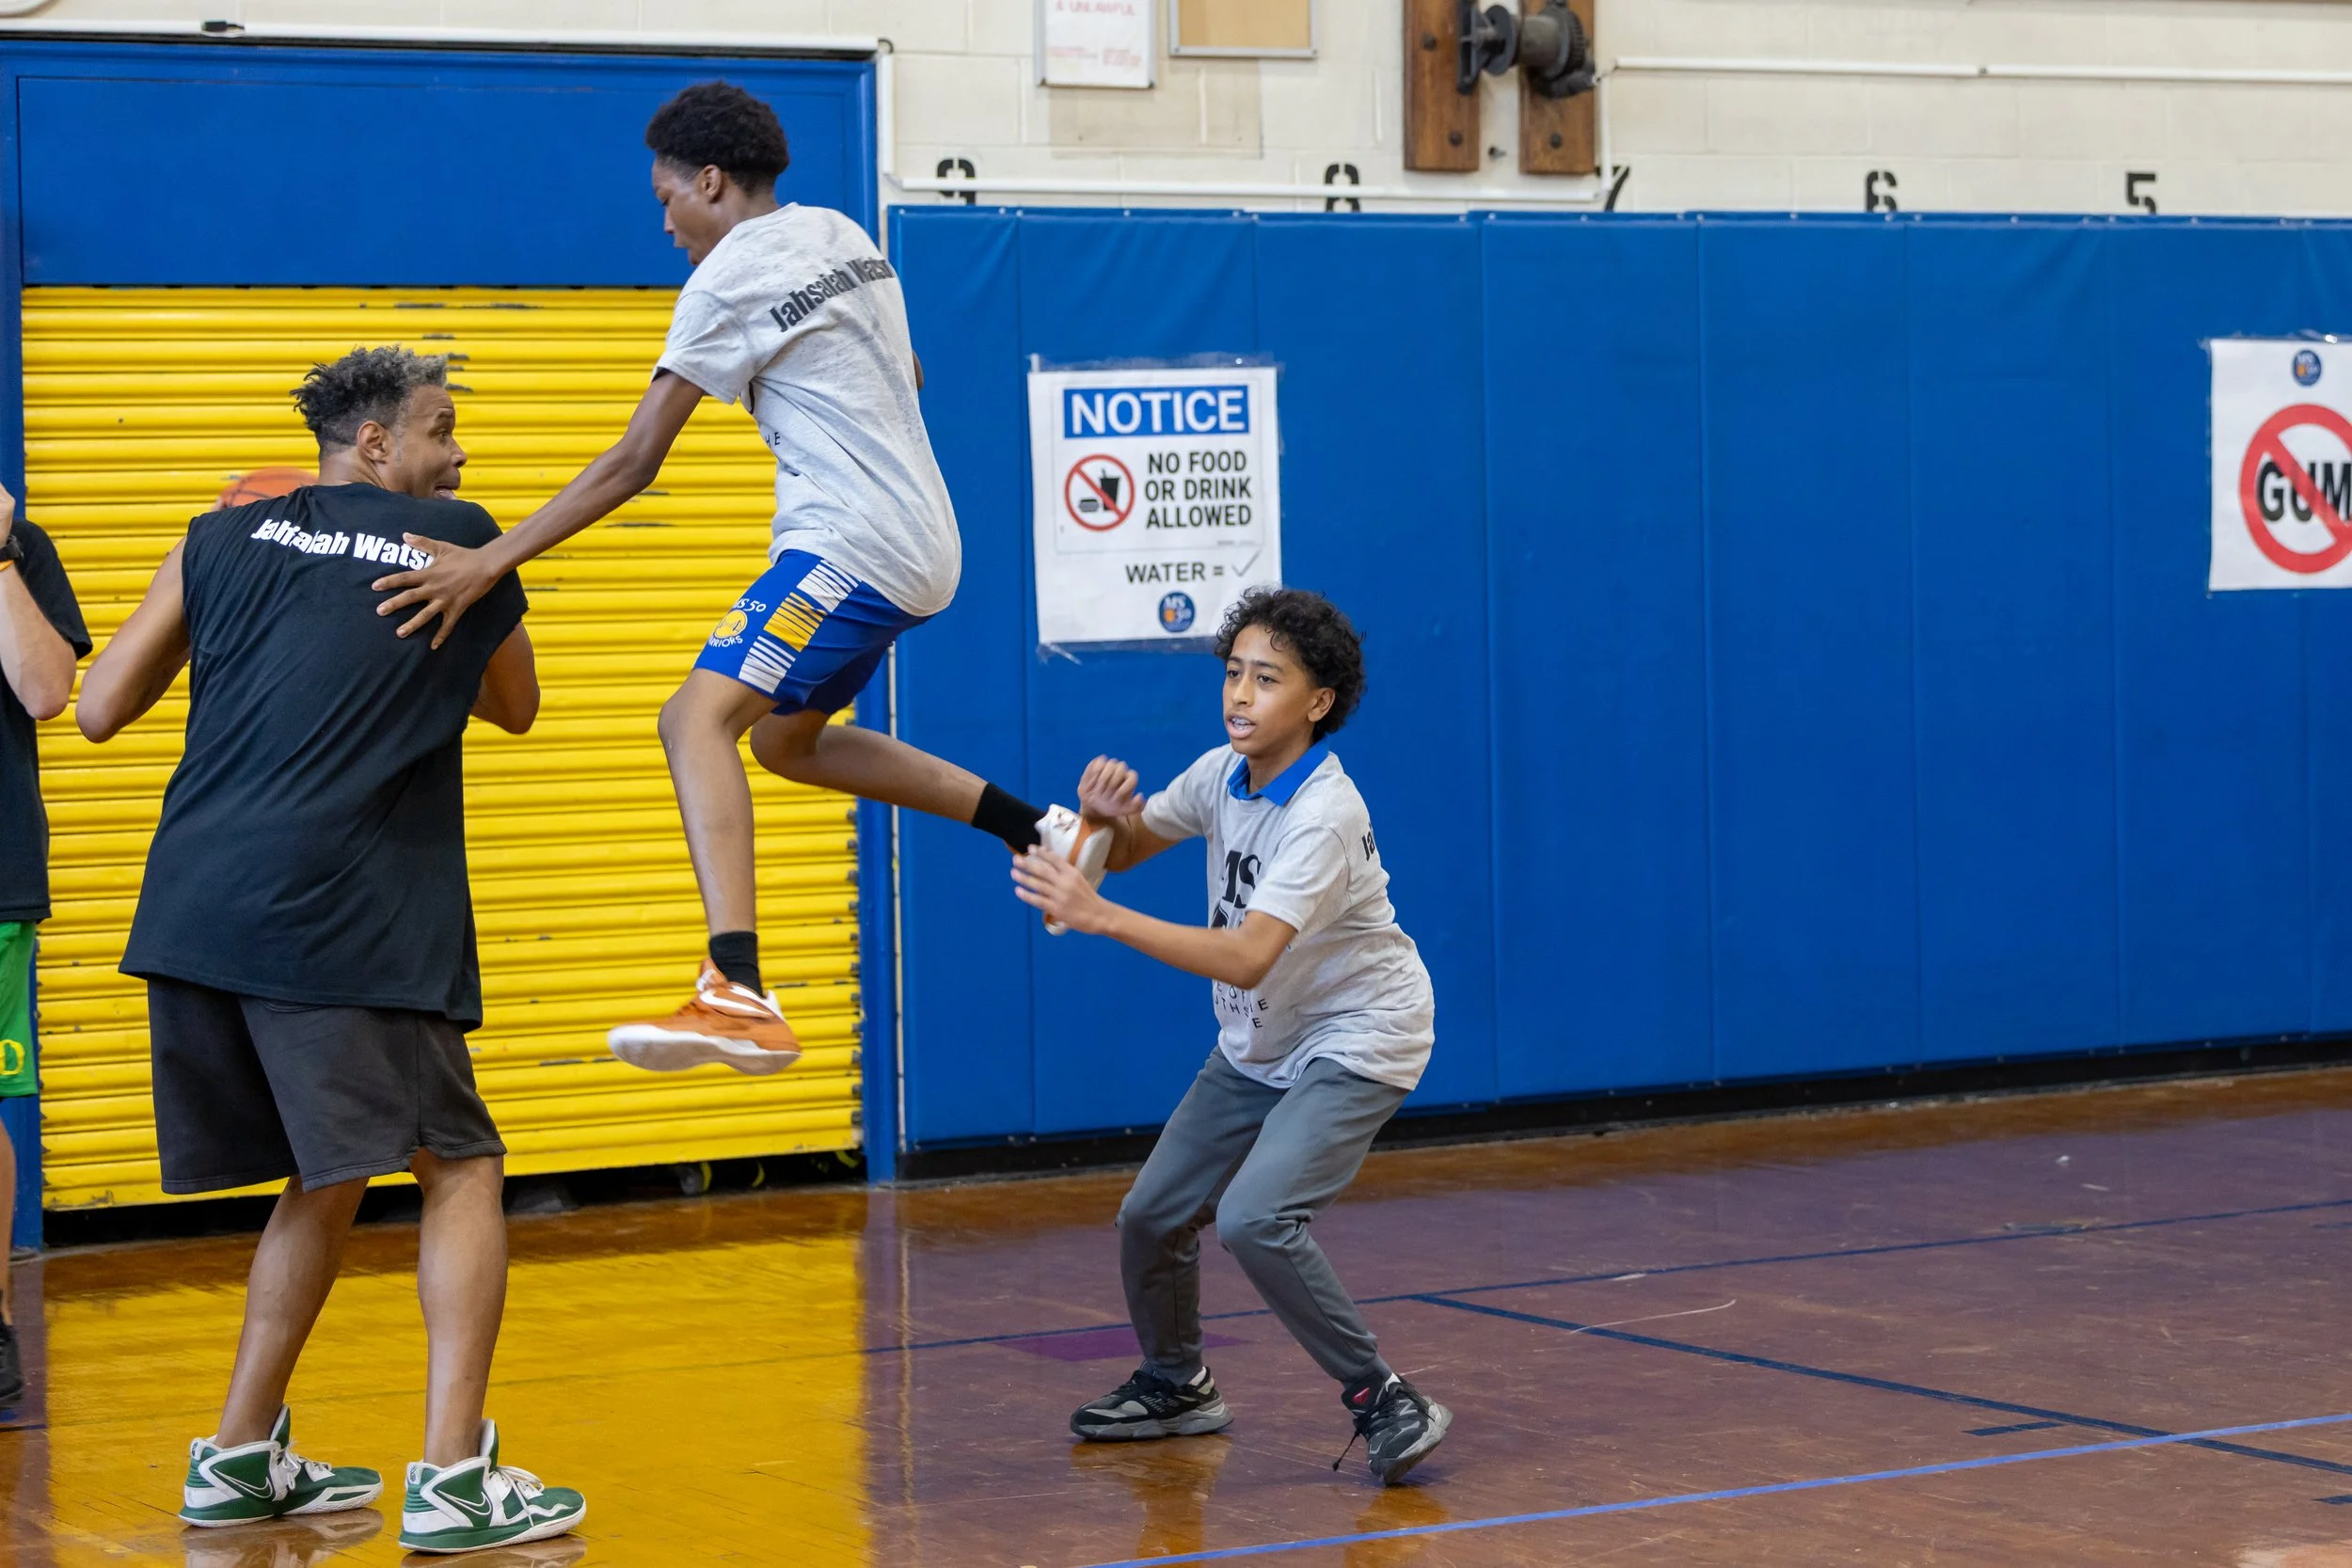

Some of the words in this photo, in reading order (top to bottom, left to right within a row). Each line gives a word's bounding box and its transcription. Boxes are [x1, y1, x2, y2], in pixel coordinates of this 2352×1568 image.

[1866, 171, 1898, 213] 6
[2125, 173, 2156, 214] 5
[1072, 390, 1245, 435] NOTICE
[1149, 452, 1180, 474] NO
[1189, 451, 1247, 472] FOOD
[1145, 481, 1175, 501] OR
[1184, 477, 1251, 499] DRINK
[2258, 460, 2352, 523] GUM
[1146, 504, 1251, 530] ALLOWED
[1125, 562, 1206, 583] WATER
